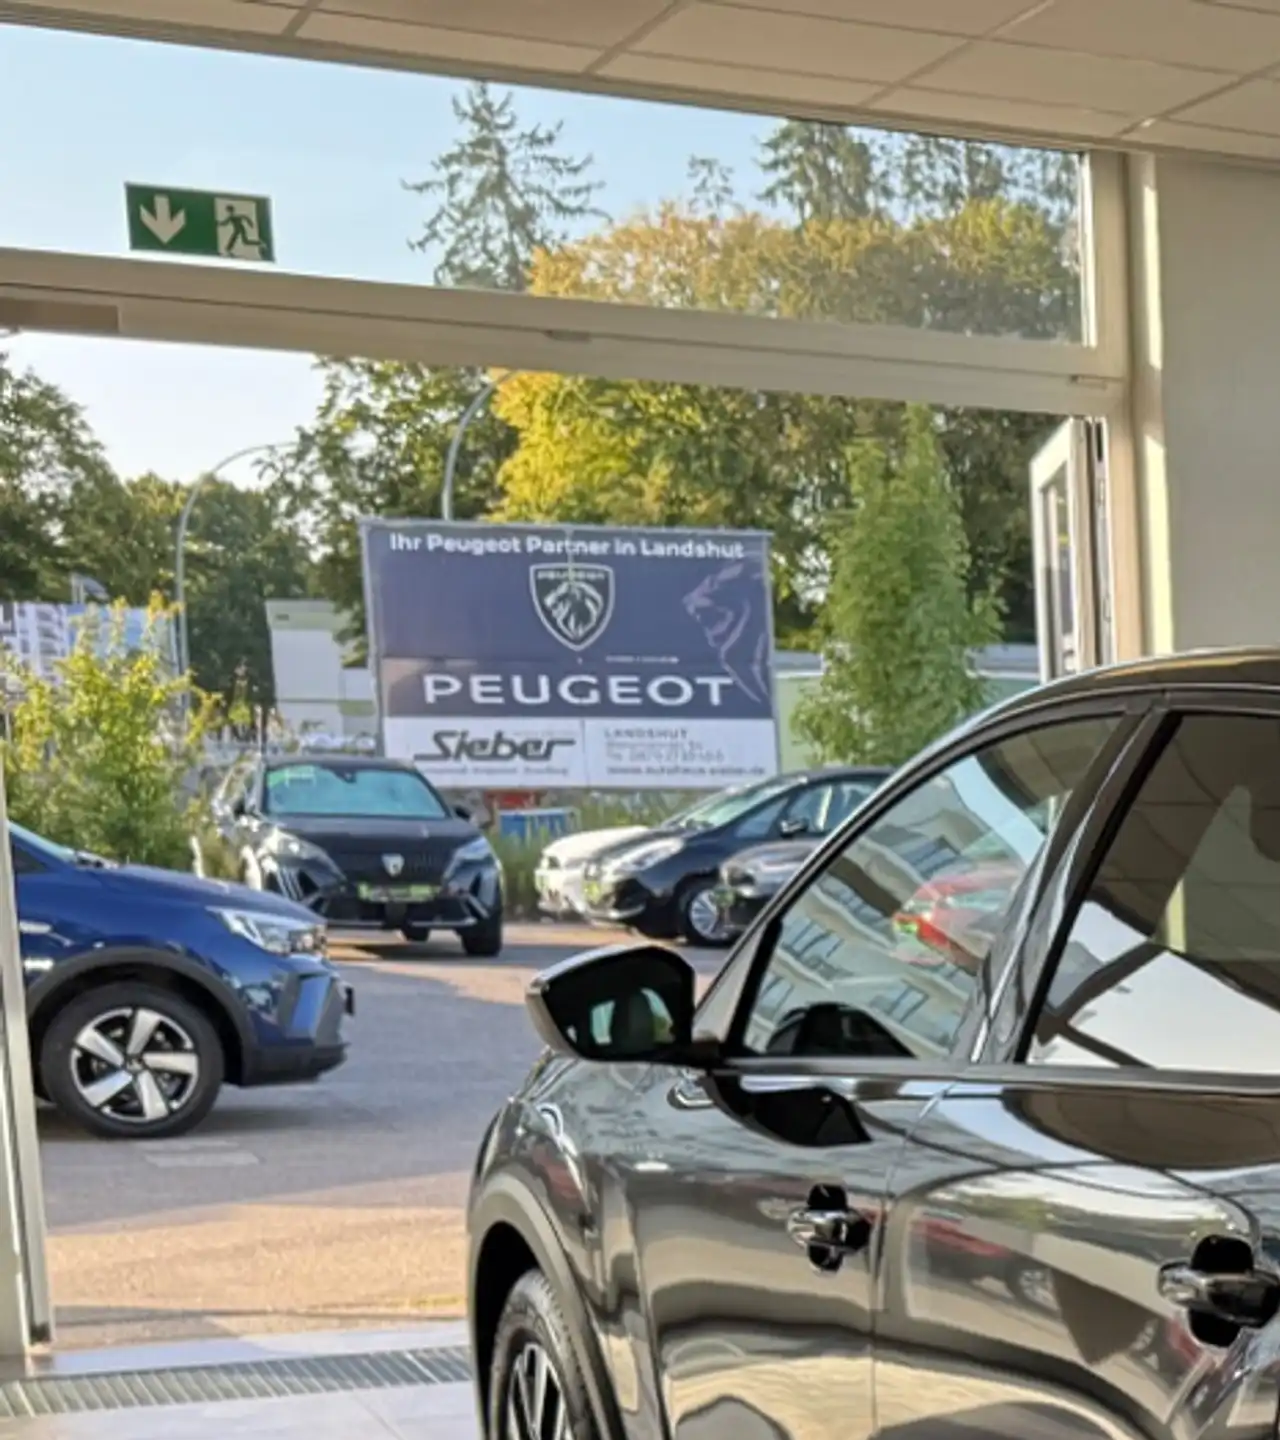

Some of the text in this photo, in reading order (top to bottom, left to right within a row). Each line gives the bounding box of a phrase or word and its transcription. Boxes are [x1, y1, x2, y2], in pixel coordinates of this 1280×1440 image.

[390, 533, 744, 559] Ihr Peugeot Partner in Landshut
[422, 673, 733, 707] PEUGEOT
[413, 730, 576, 762] Sieber
